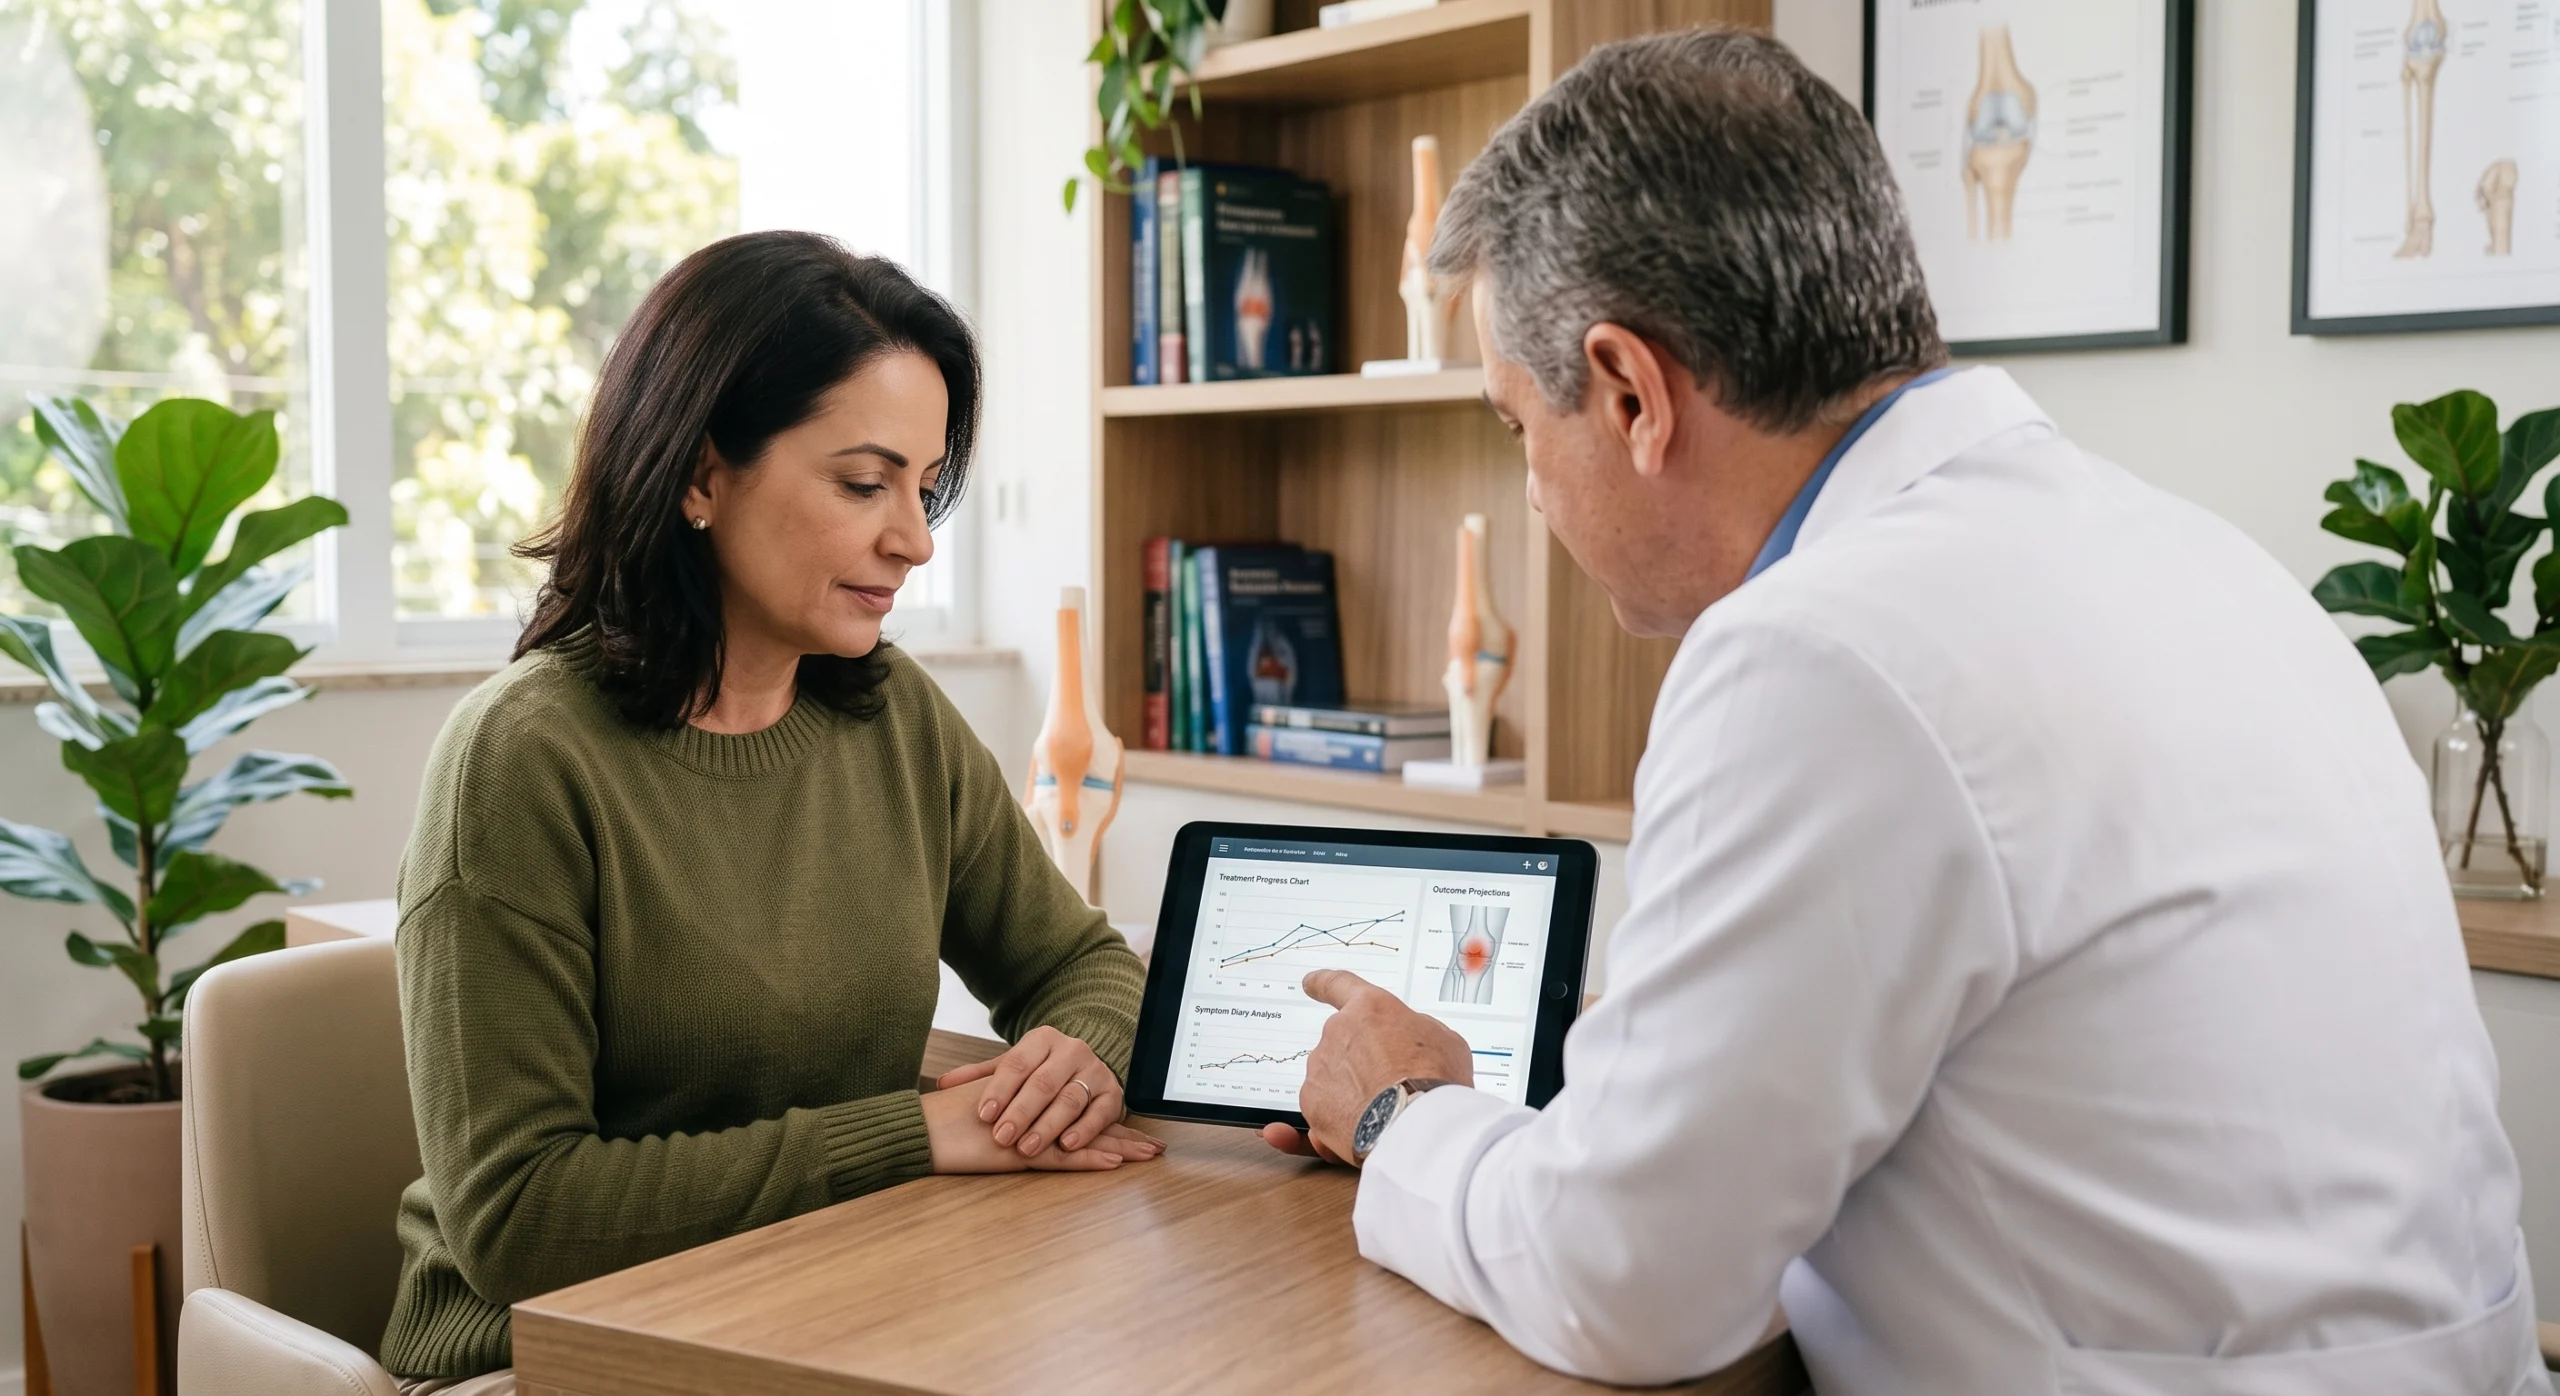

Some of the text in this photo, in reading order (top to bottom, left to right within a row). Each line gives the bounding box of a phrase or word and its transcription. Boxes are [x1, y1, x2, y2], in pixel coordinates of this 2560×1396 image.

[1219, 873, 1310, 885] Treatment Progress Chart
[1432, 885, 1511, 897] Outcome Projections
[1194, 1005, 1282, 1020] Symptom Diary Analysis
